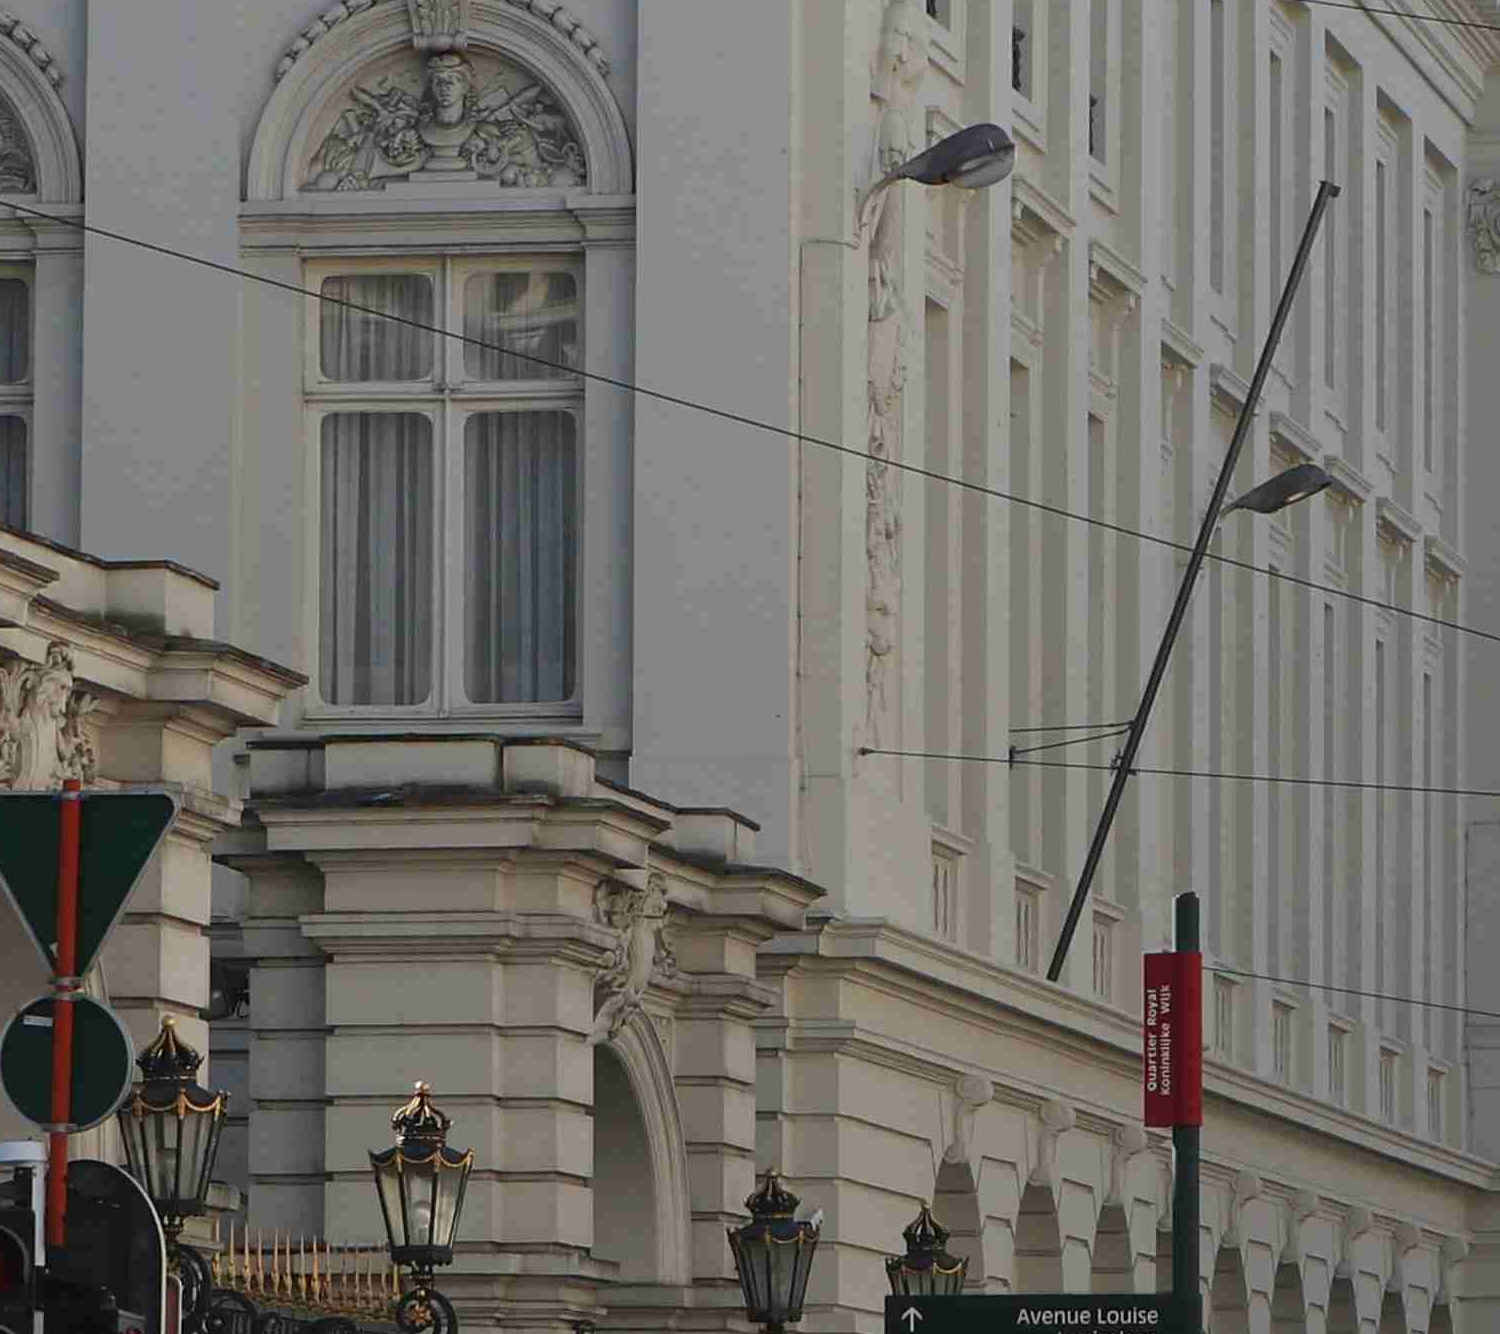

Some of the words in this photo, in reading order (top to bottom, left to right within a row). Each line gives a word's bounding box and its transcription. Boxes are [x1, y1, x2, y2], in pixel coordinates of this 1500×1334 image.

[1147, 989, 1158, 1026] Royal
[1160, 985, 1171, 1014] Wijk
[1147, 1033, 1157, 1092] Quartier
[1017, 1308, 1091, 1324] Avenue
[1097, 1307, 1159, 1324] Louise
